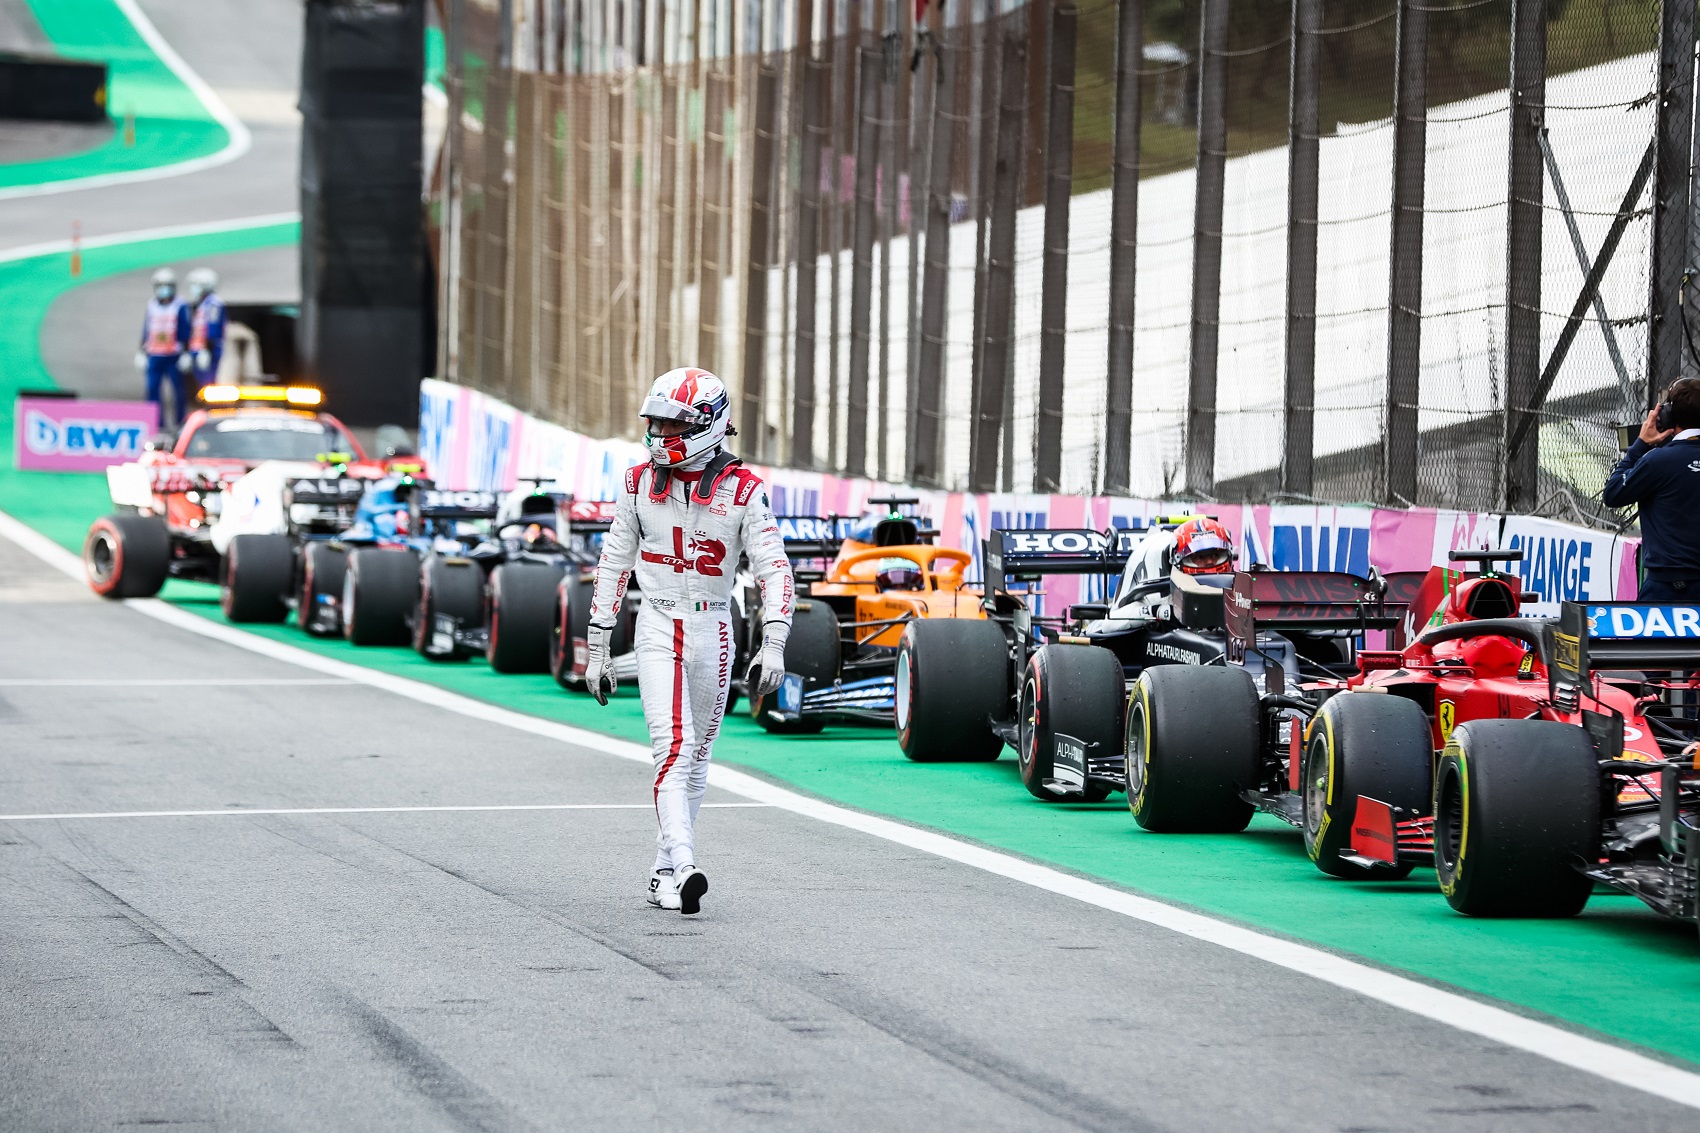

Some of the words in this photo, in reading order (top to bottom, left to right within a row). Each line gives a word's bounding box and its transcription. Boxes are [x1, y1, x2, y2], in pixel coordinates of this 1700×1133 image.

[65, 426, 141, 450] BWT
[292, 479, 374, 494] ALPI
[718, 620, 729, 689] ANTONIO
